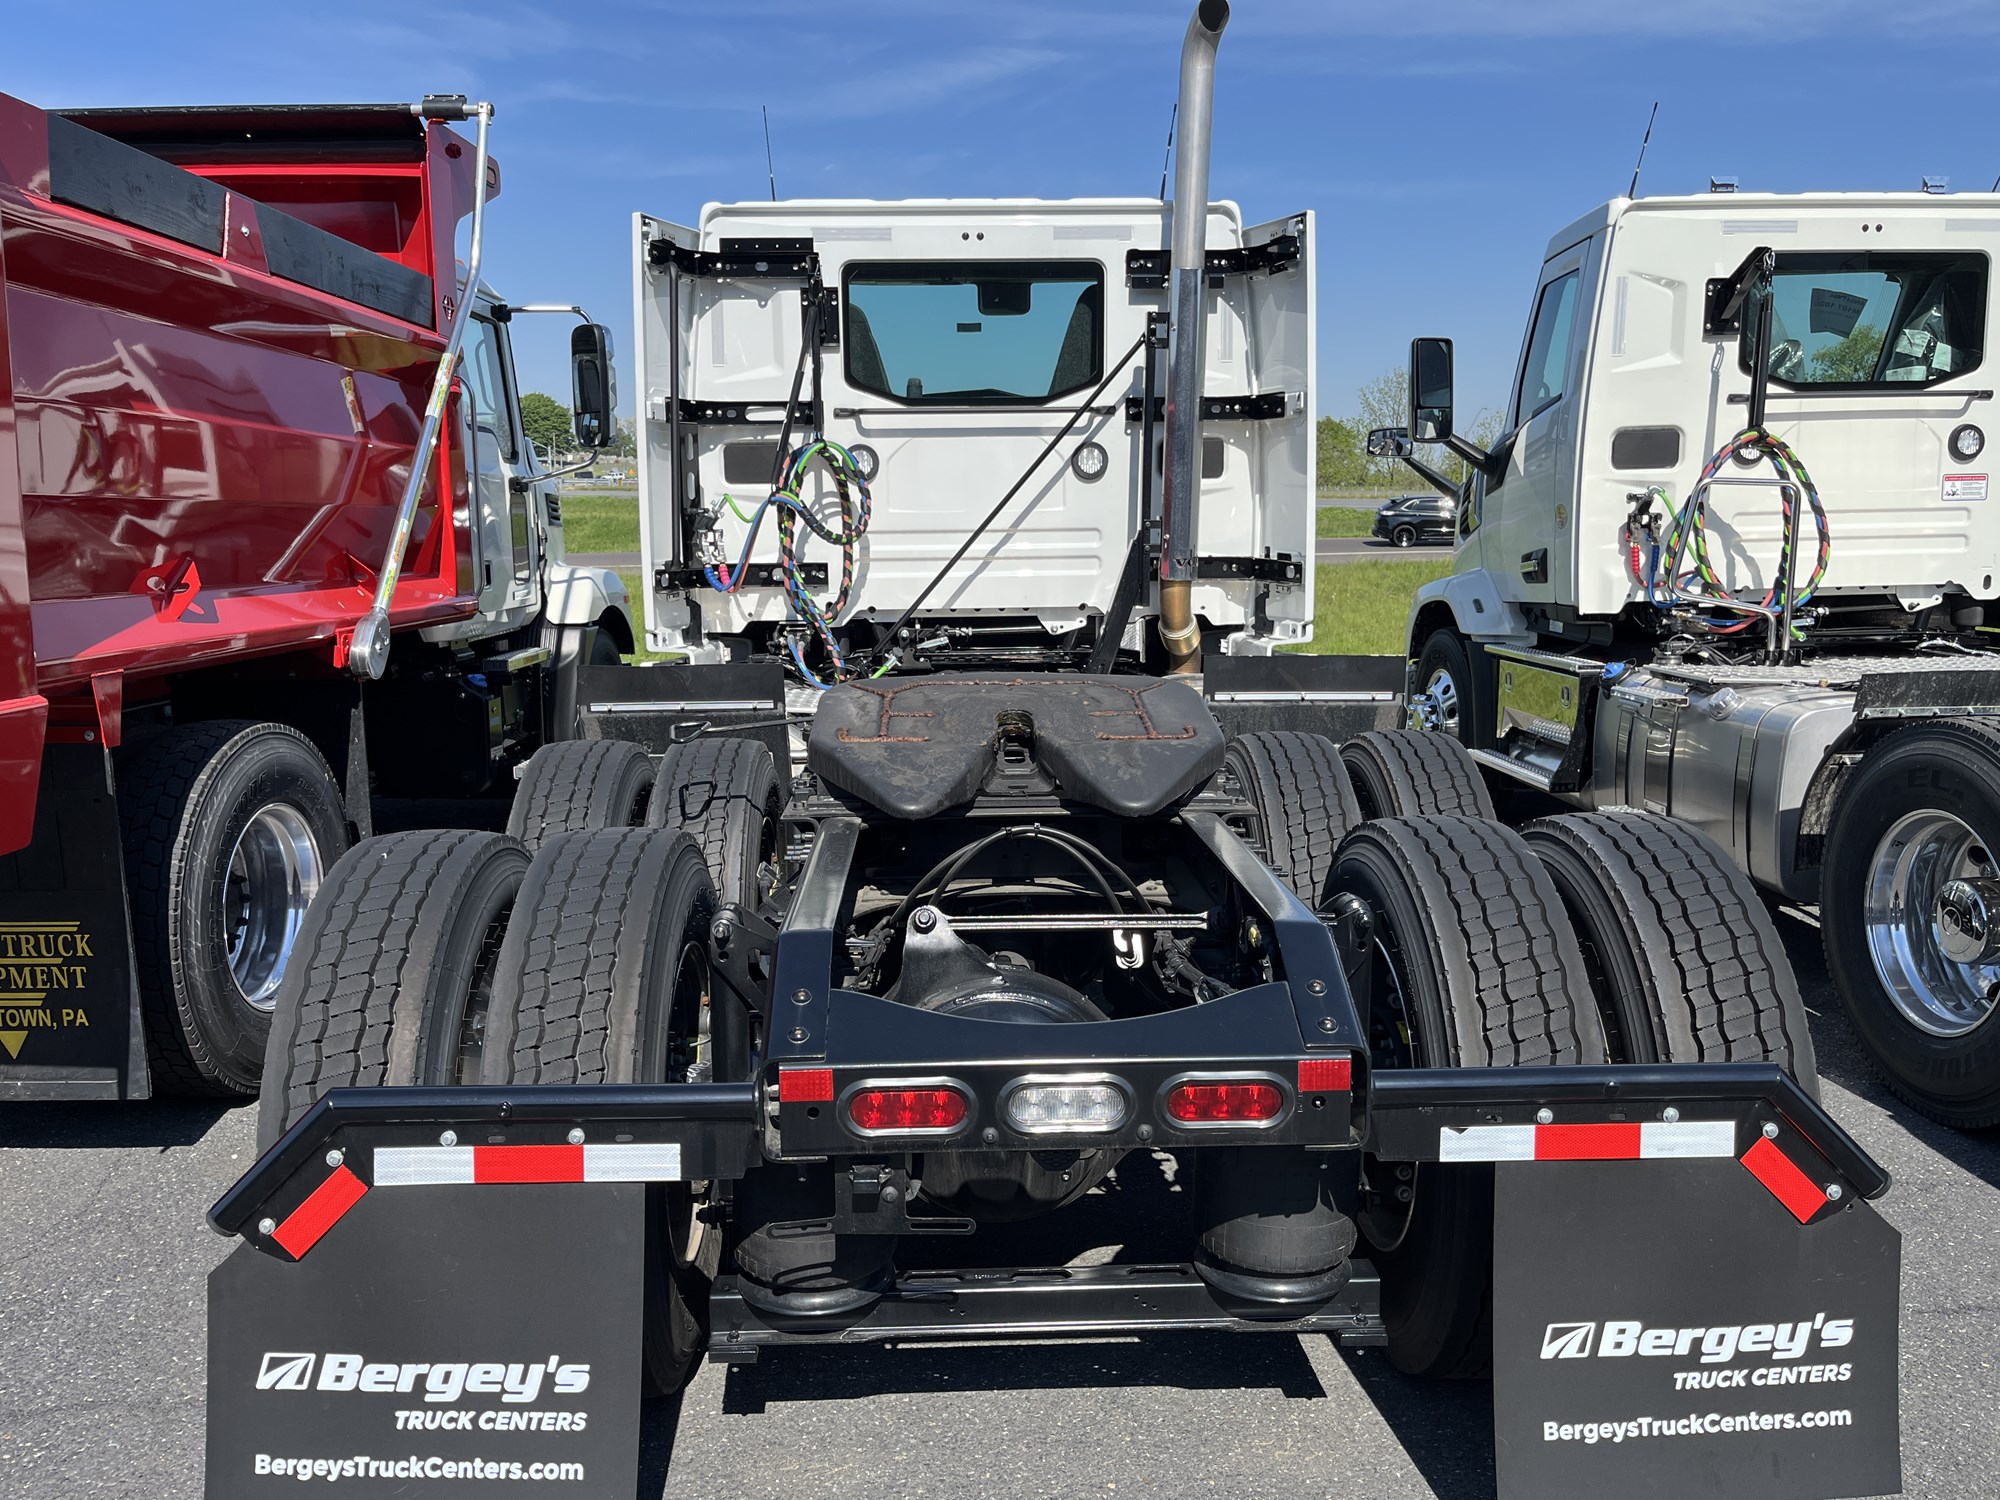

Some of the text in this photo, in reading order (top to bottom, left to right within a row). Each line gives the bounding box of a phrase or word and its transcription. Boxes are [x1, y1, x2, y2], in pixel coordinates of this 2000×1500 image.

[1, 934, 93, 957] TRUCK
[62, 1008, 90, 1027] PA
[1596, 1312, 1855, 1364] Bergey's
[317, 1352, 591, 1403] Bergey's
[1673, 1362, 1853, 1391] TRUCK CENTERS
[394, 1409, 588, 1432] TRUCK CENTERS
[1542, 1408, 1853, 1444] BergeysTruckCenters.com
[254, 1452, 585, 1483] BergeysTruckCenters.com
